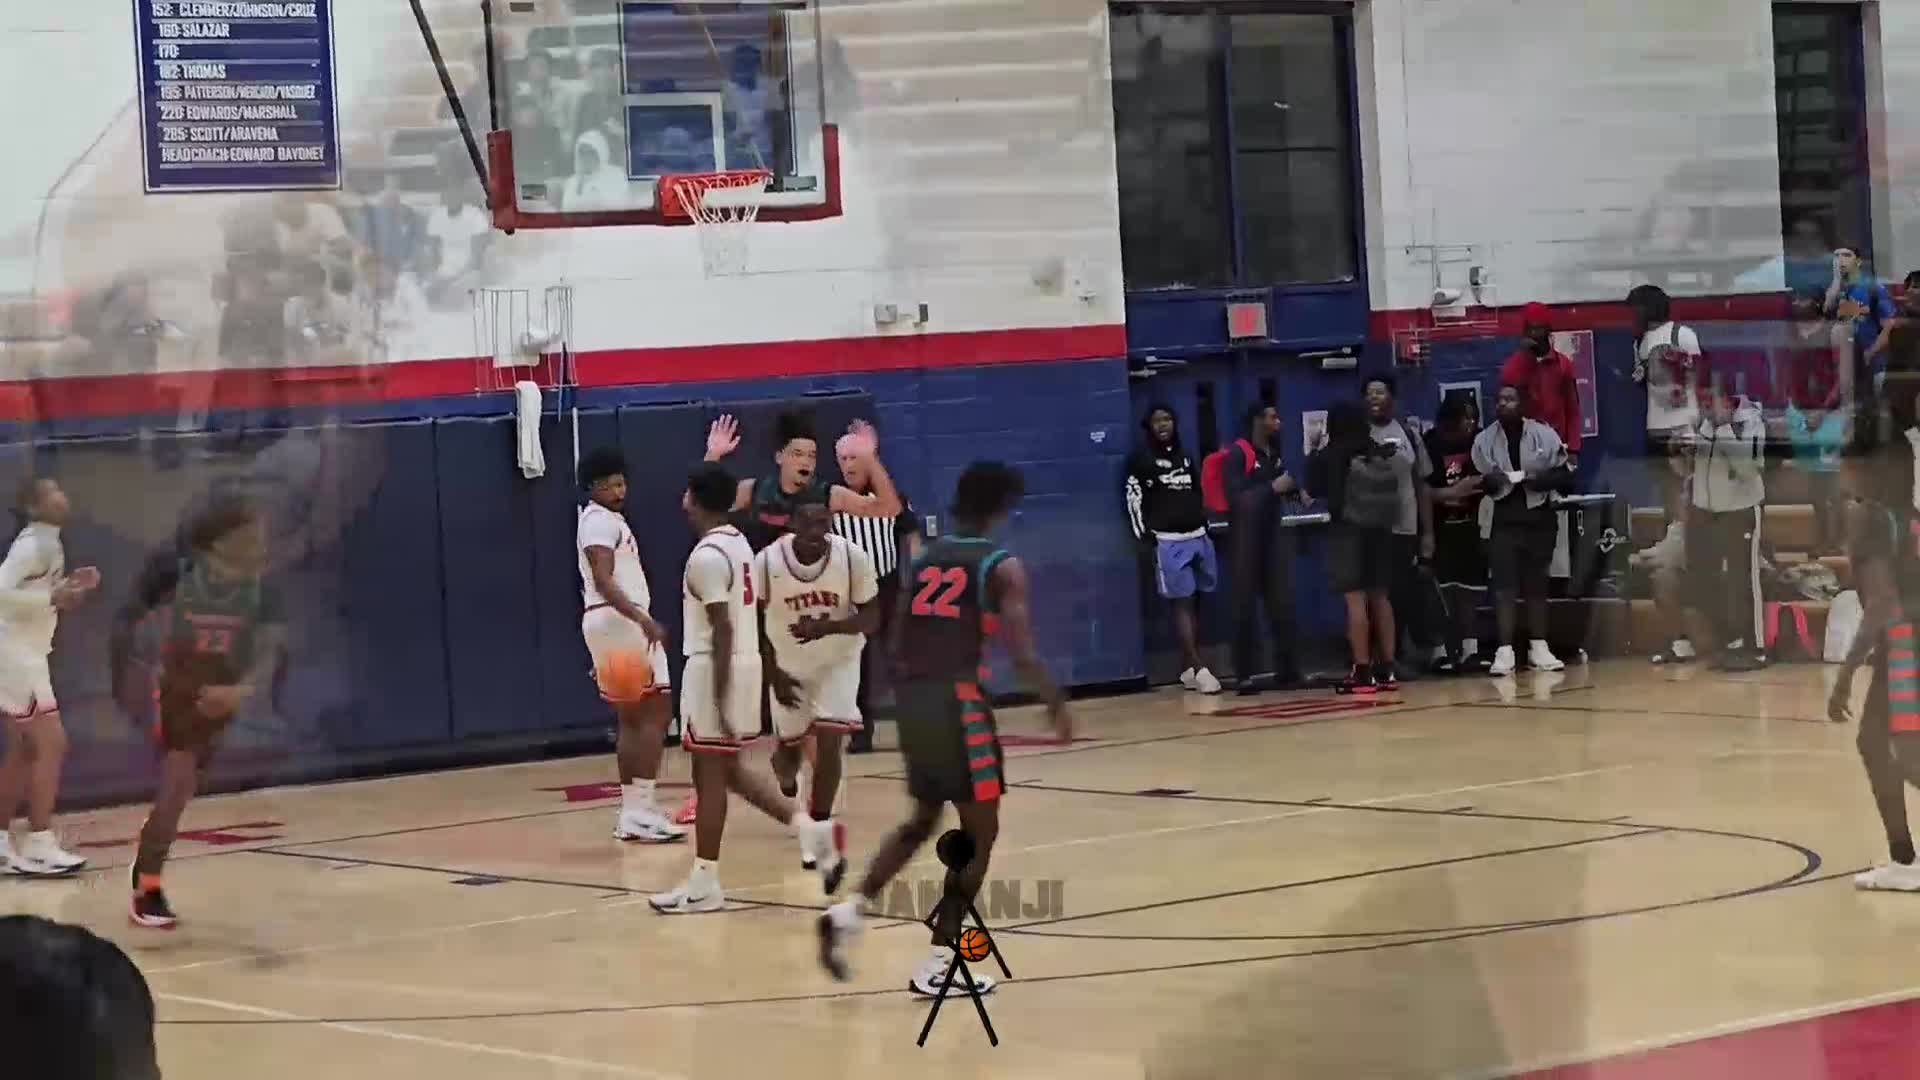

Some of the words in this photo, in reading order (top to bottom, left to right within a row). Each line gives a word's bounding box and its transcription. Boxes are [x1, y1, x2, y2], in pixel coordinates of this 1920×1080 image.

[182, 64, 226, 79] THOMAS
[784, 590, 839, 611] TITANS
[912, 566, 968, 618] 22
